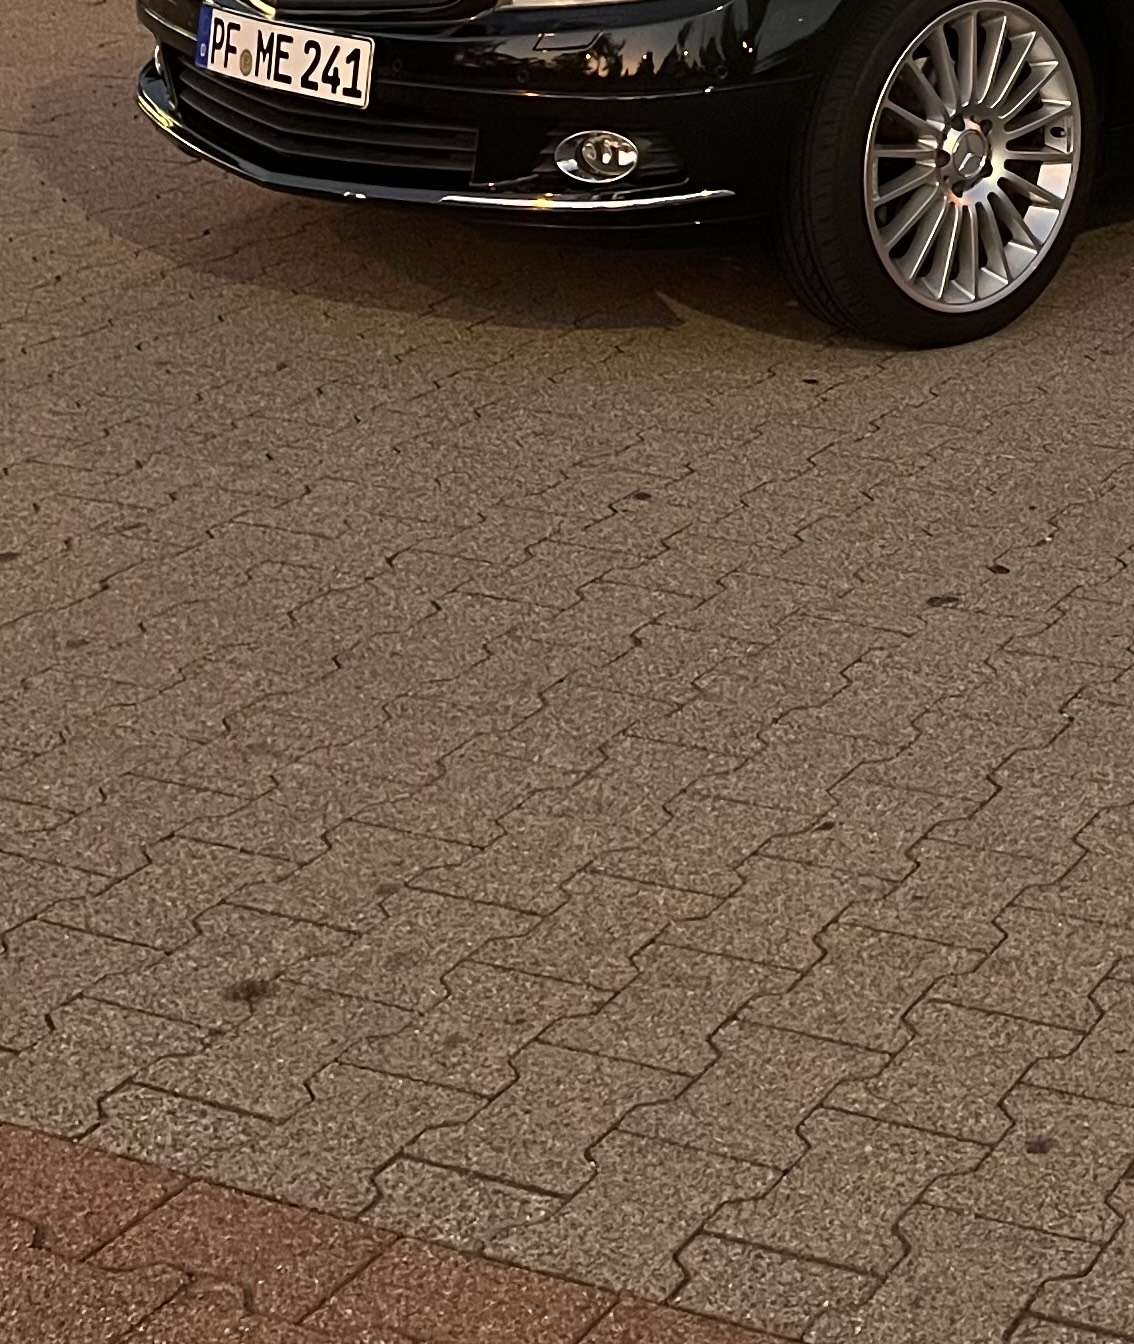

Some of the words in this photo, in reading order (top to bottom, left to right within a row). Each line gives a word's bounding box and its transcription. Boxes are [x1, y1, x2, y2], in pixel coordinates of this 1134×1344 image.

[210, 17, 241, 68] PF
[254, 29, 294, 85] ME
[300, 40, 362, 99] 241
